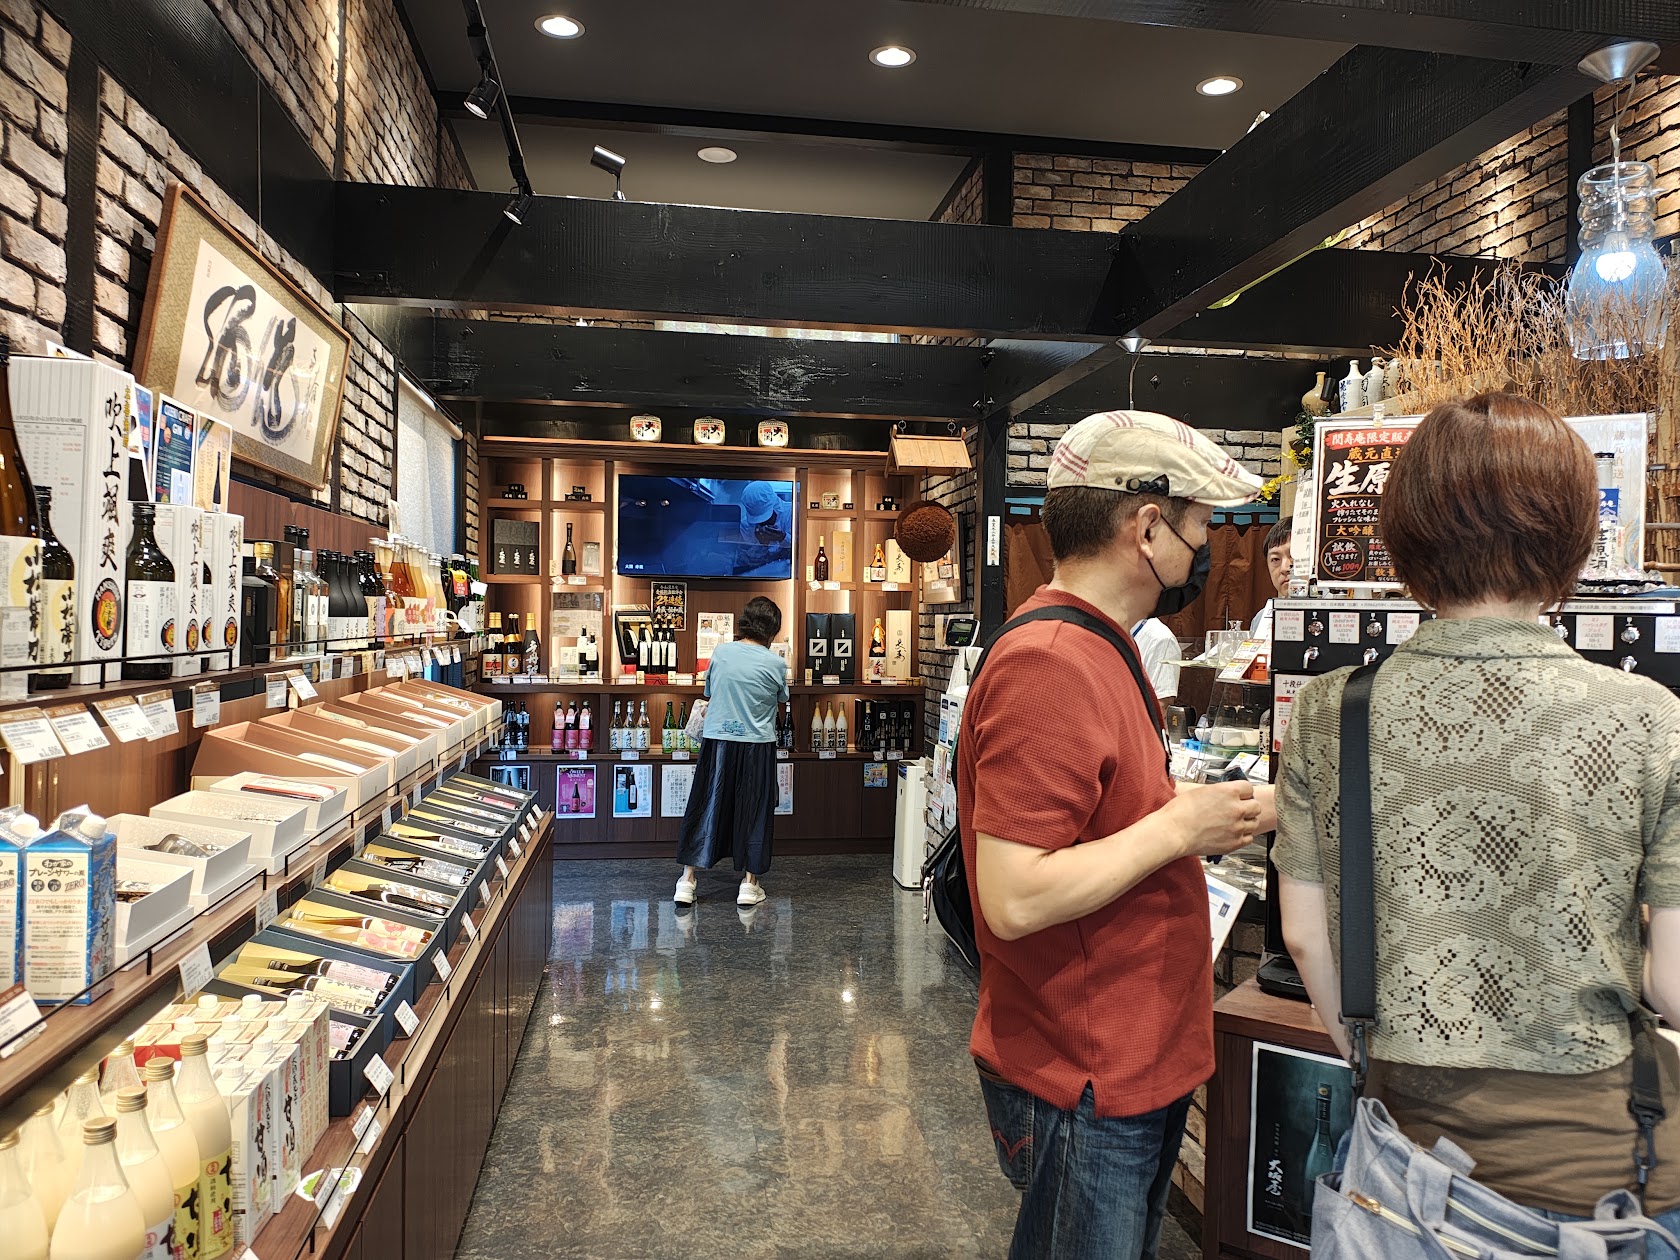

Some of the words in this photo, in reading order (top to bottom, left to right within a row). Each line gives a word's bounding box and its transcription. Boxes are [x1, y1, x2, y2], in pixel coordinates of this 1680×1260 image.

[1331, 499, 1374, 508] 火入れなし
[1336, 525, 1374, 536] 大吟醸
[1332, 542, 1356, 552] 試飲
[23, 544, 41, 663] 小松帯刀
[1283, 680, 1305, 688] 十段仕
[43, 860, 73, 868] わが家の
[28, 868, 85, 877] プレーンサワーの素
[64, 878, 86, 893] ZERO
[1266, 1159, 1284, 1196] 大坂屋
